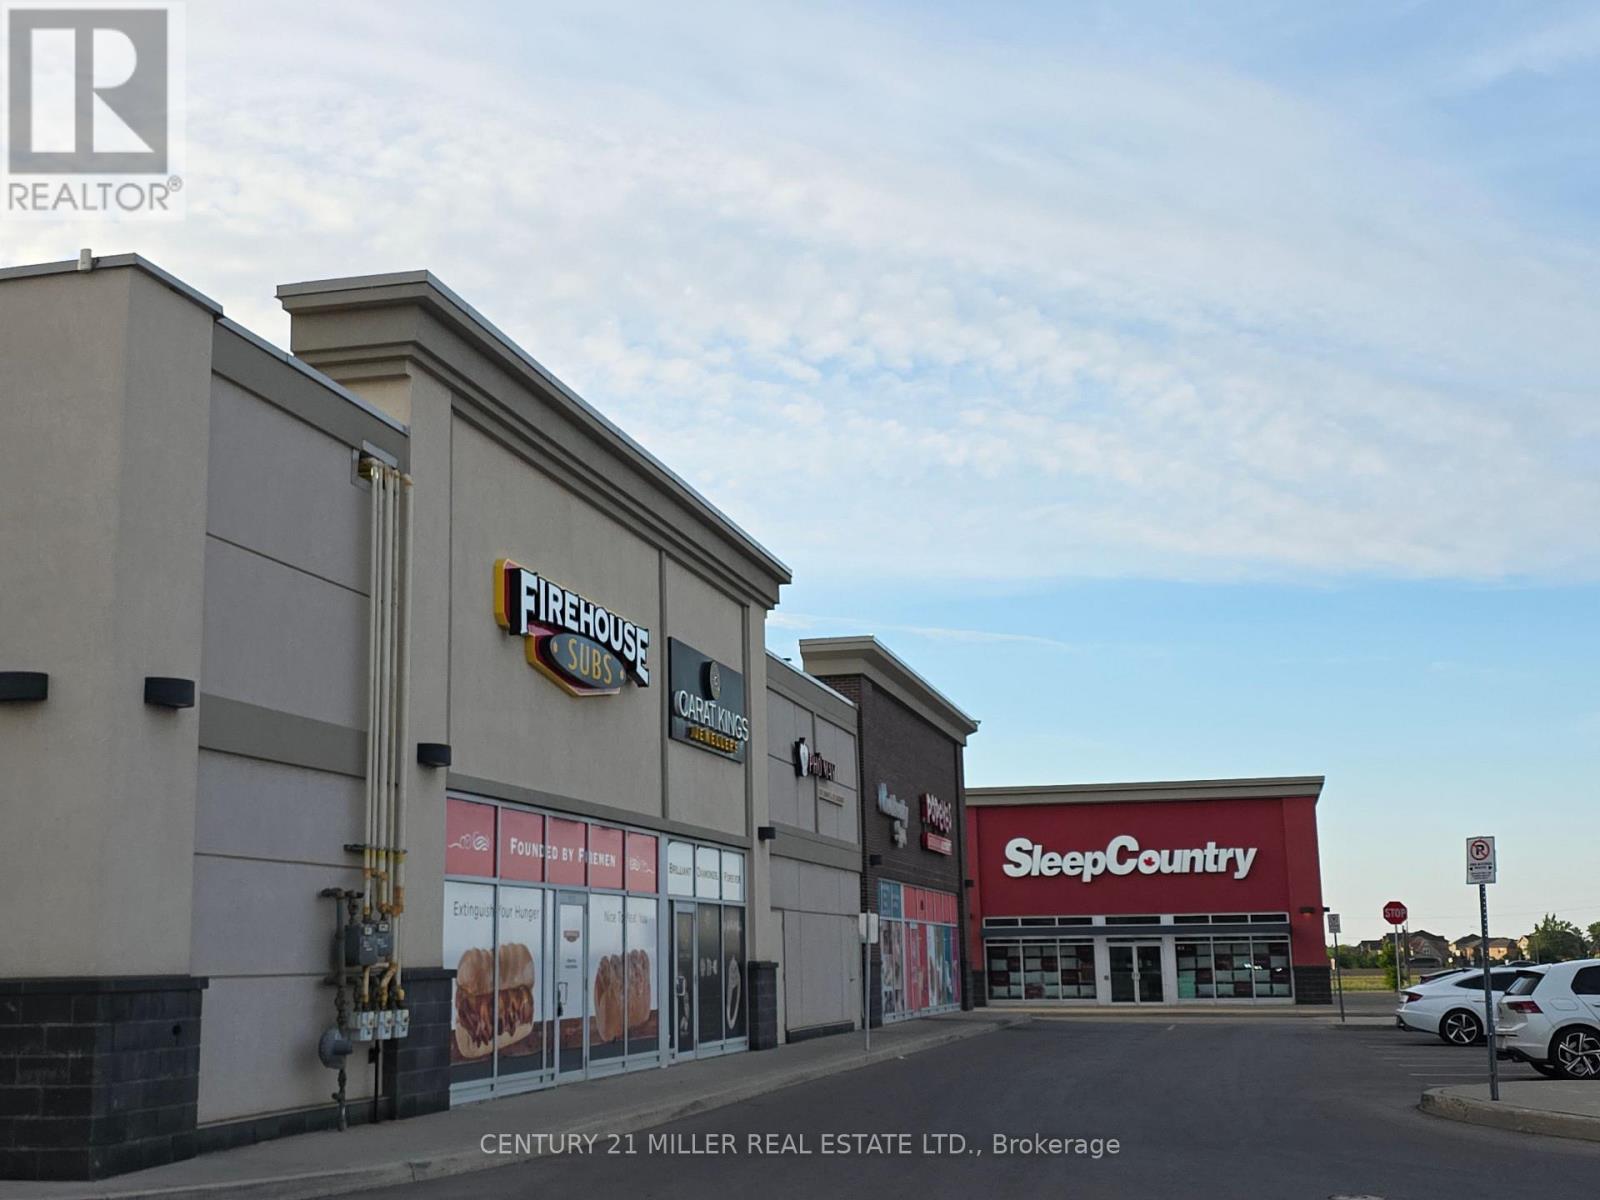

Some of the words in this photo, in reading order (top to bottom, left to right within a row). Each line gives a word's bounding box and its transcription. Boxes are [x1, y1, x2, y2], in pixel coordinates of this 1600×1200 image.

[519, 569, 649, 687] FIREHOUSE
[567, 637, 613, 685] SUBS
[677, 690, 717, 728] CARAT
[718, 706, 749, 742] KINGS
[562, 847, 574, 861] BY
[1384, 908, 1407, 918] STOP
